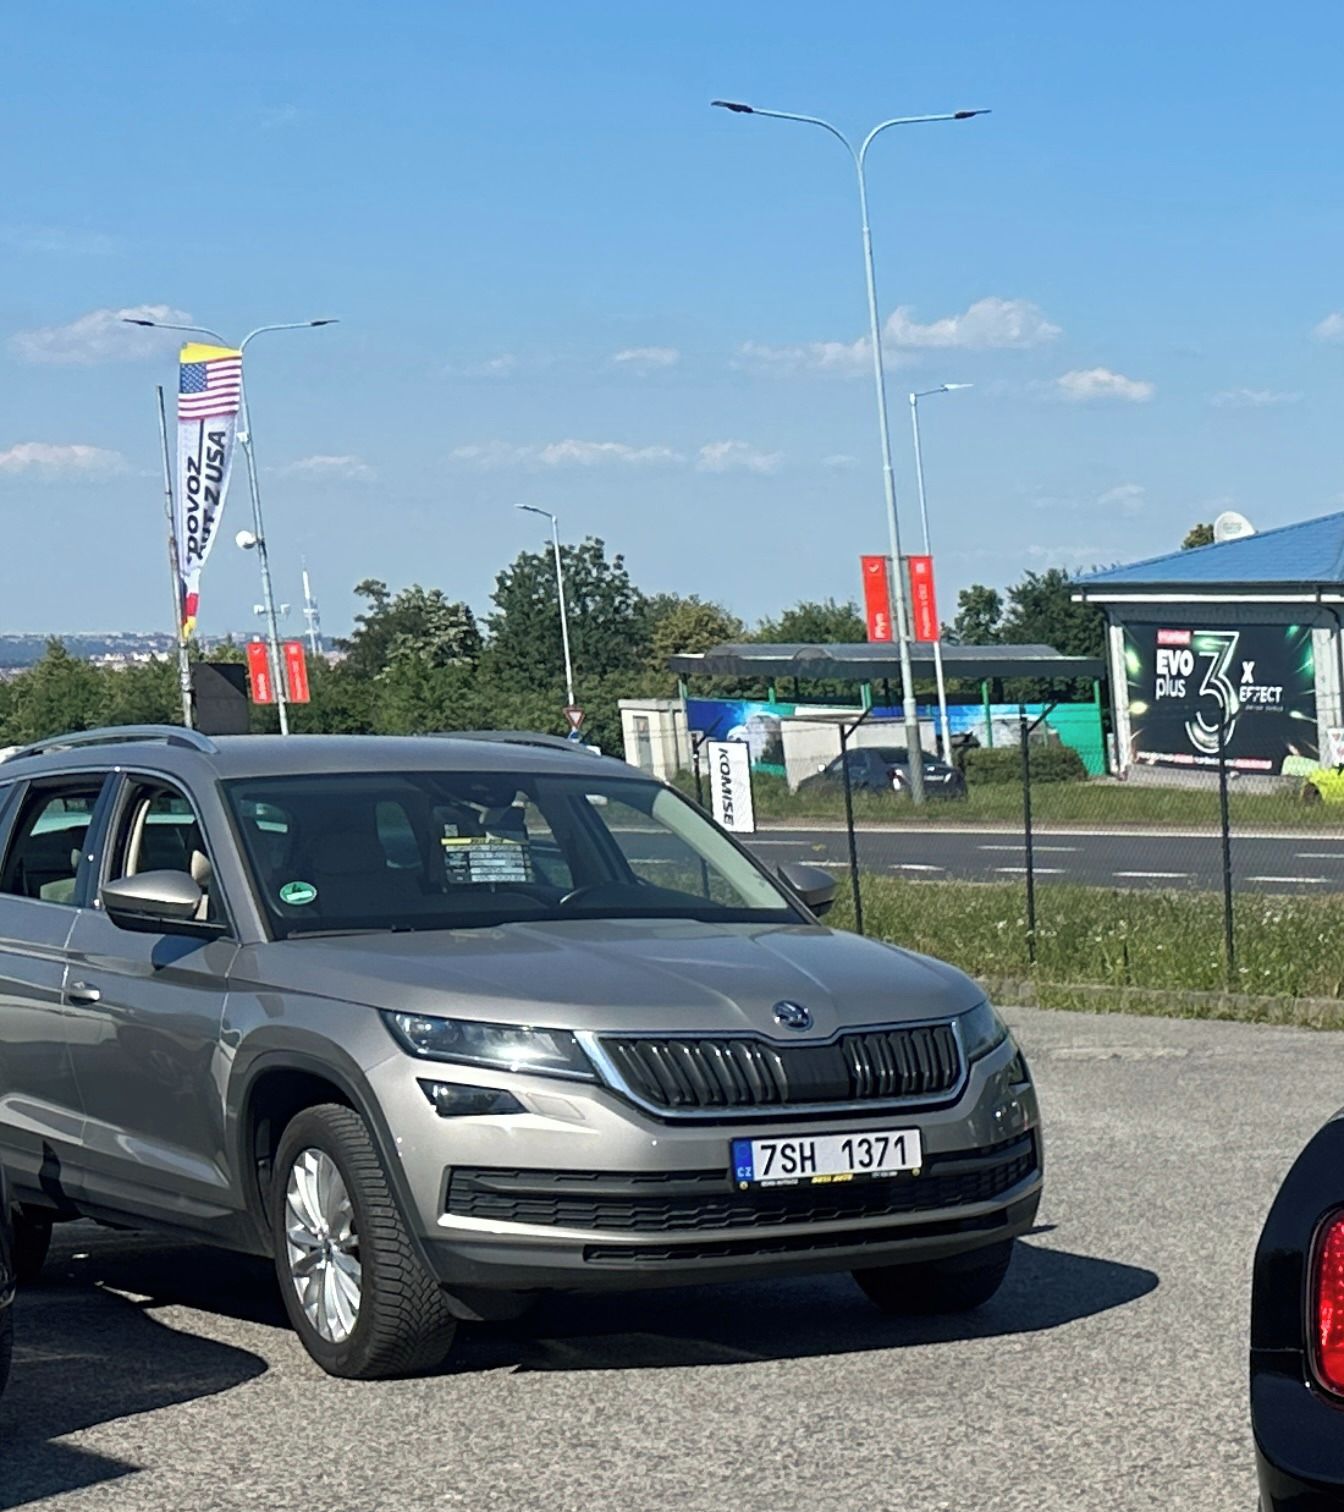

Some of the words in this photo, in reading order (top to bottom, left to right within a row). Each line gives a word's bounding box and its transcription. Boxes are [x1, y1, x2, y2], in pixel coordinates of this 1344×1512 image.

[205, 431, 227, 484] USA
[204, 486, 220, 506] Z
[1156, 649, 1194, 677] EVO
[1156, 673, 1187, 701] plus
[718, 748, 734, 826] KOMISE
[760, 1141, 816, 1177] 7SH
[841, 1135, 907, 1171] 1371
[737, 1166, 752, 1178] CZ
